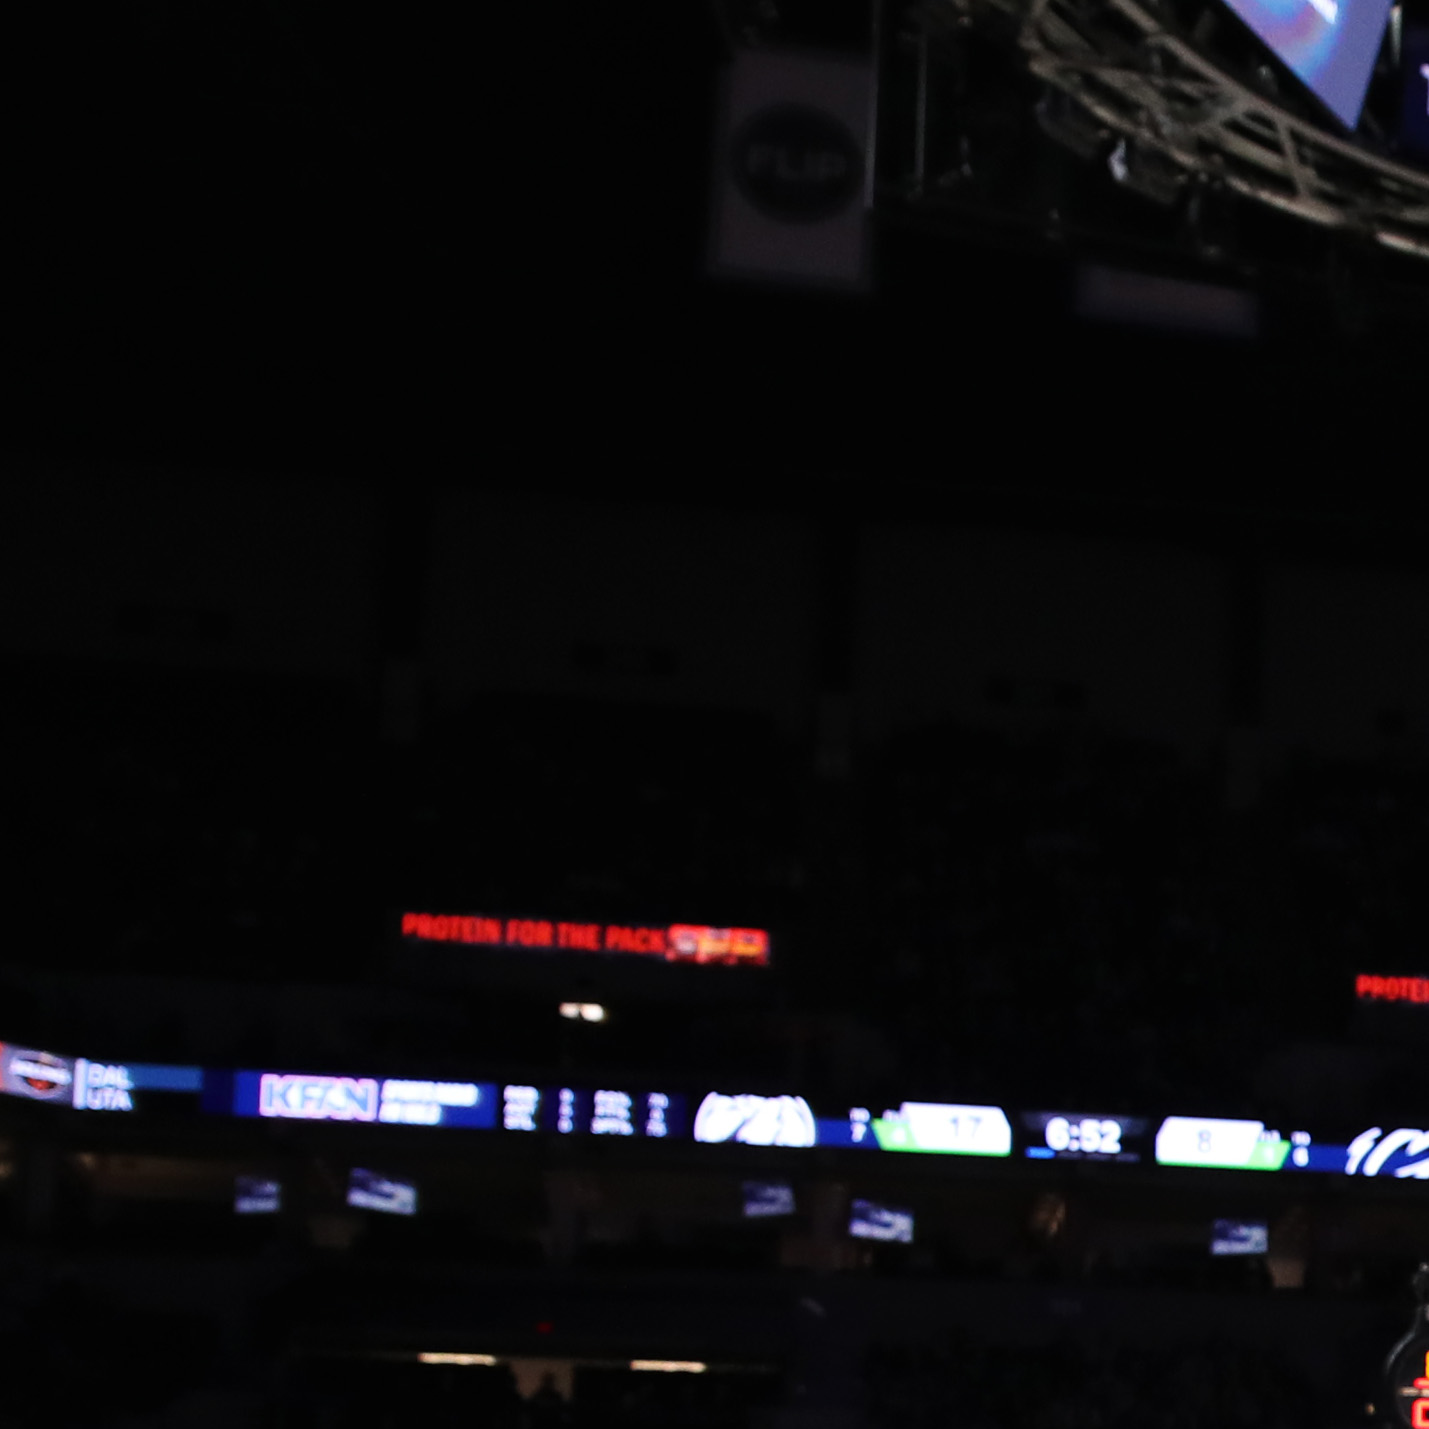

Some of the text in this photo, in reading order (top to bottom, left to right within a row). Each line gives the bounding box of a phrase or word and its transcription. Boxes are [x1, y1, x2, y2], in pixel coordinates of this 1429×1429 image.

[506, 919, 553, 947] FOR
[260, 1073, 378, 1122] KFAN
[1045, 1116, 1122, 1154] 6:52
